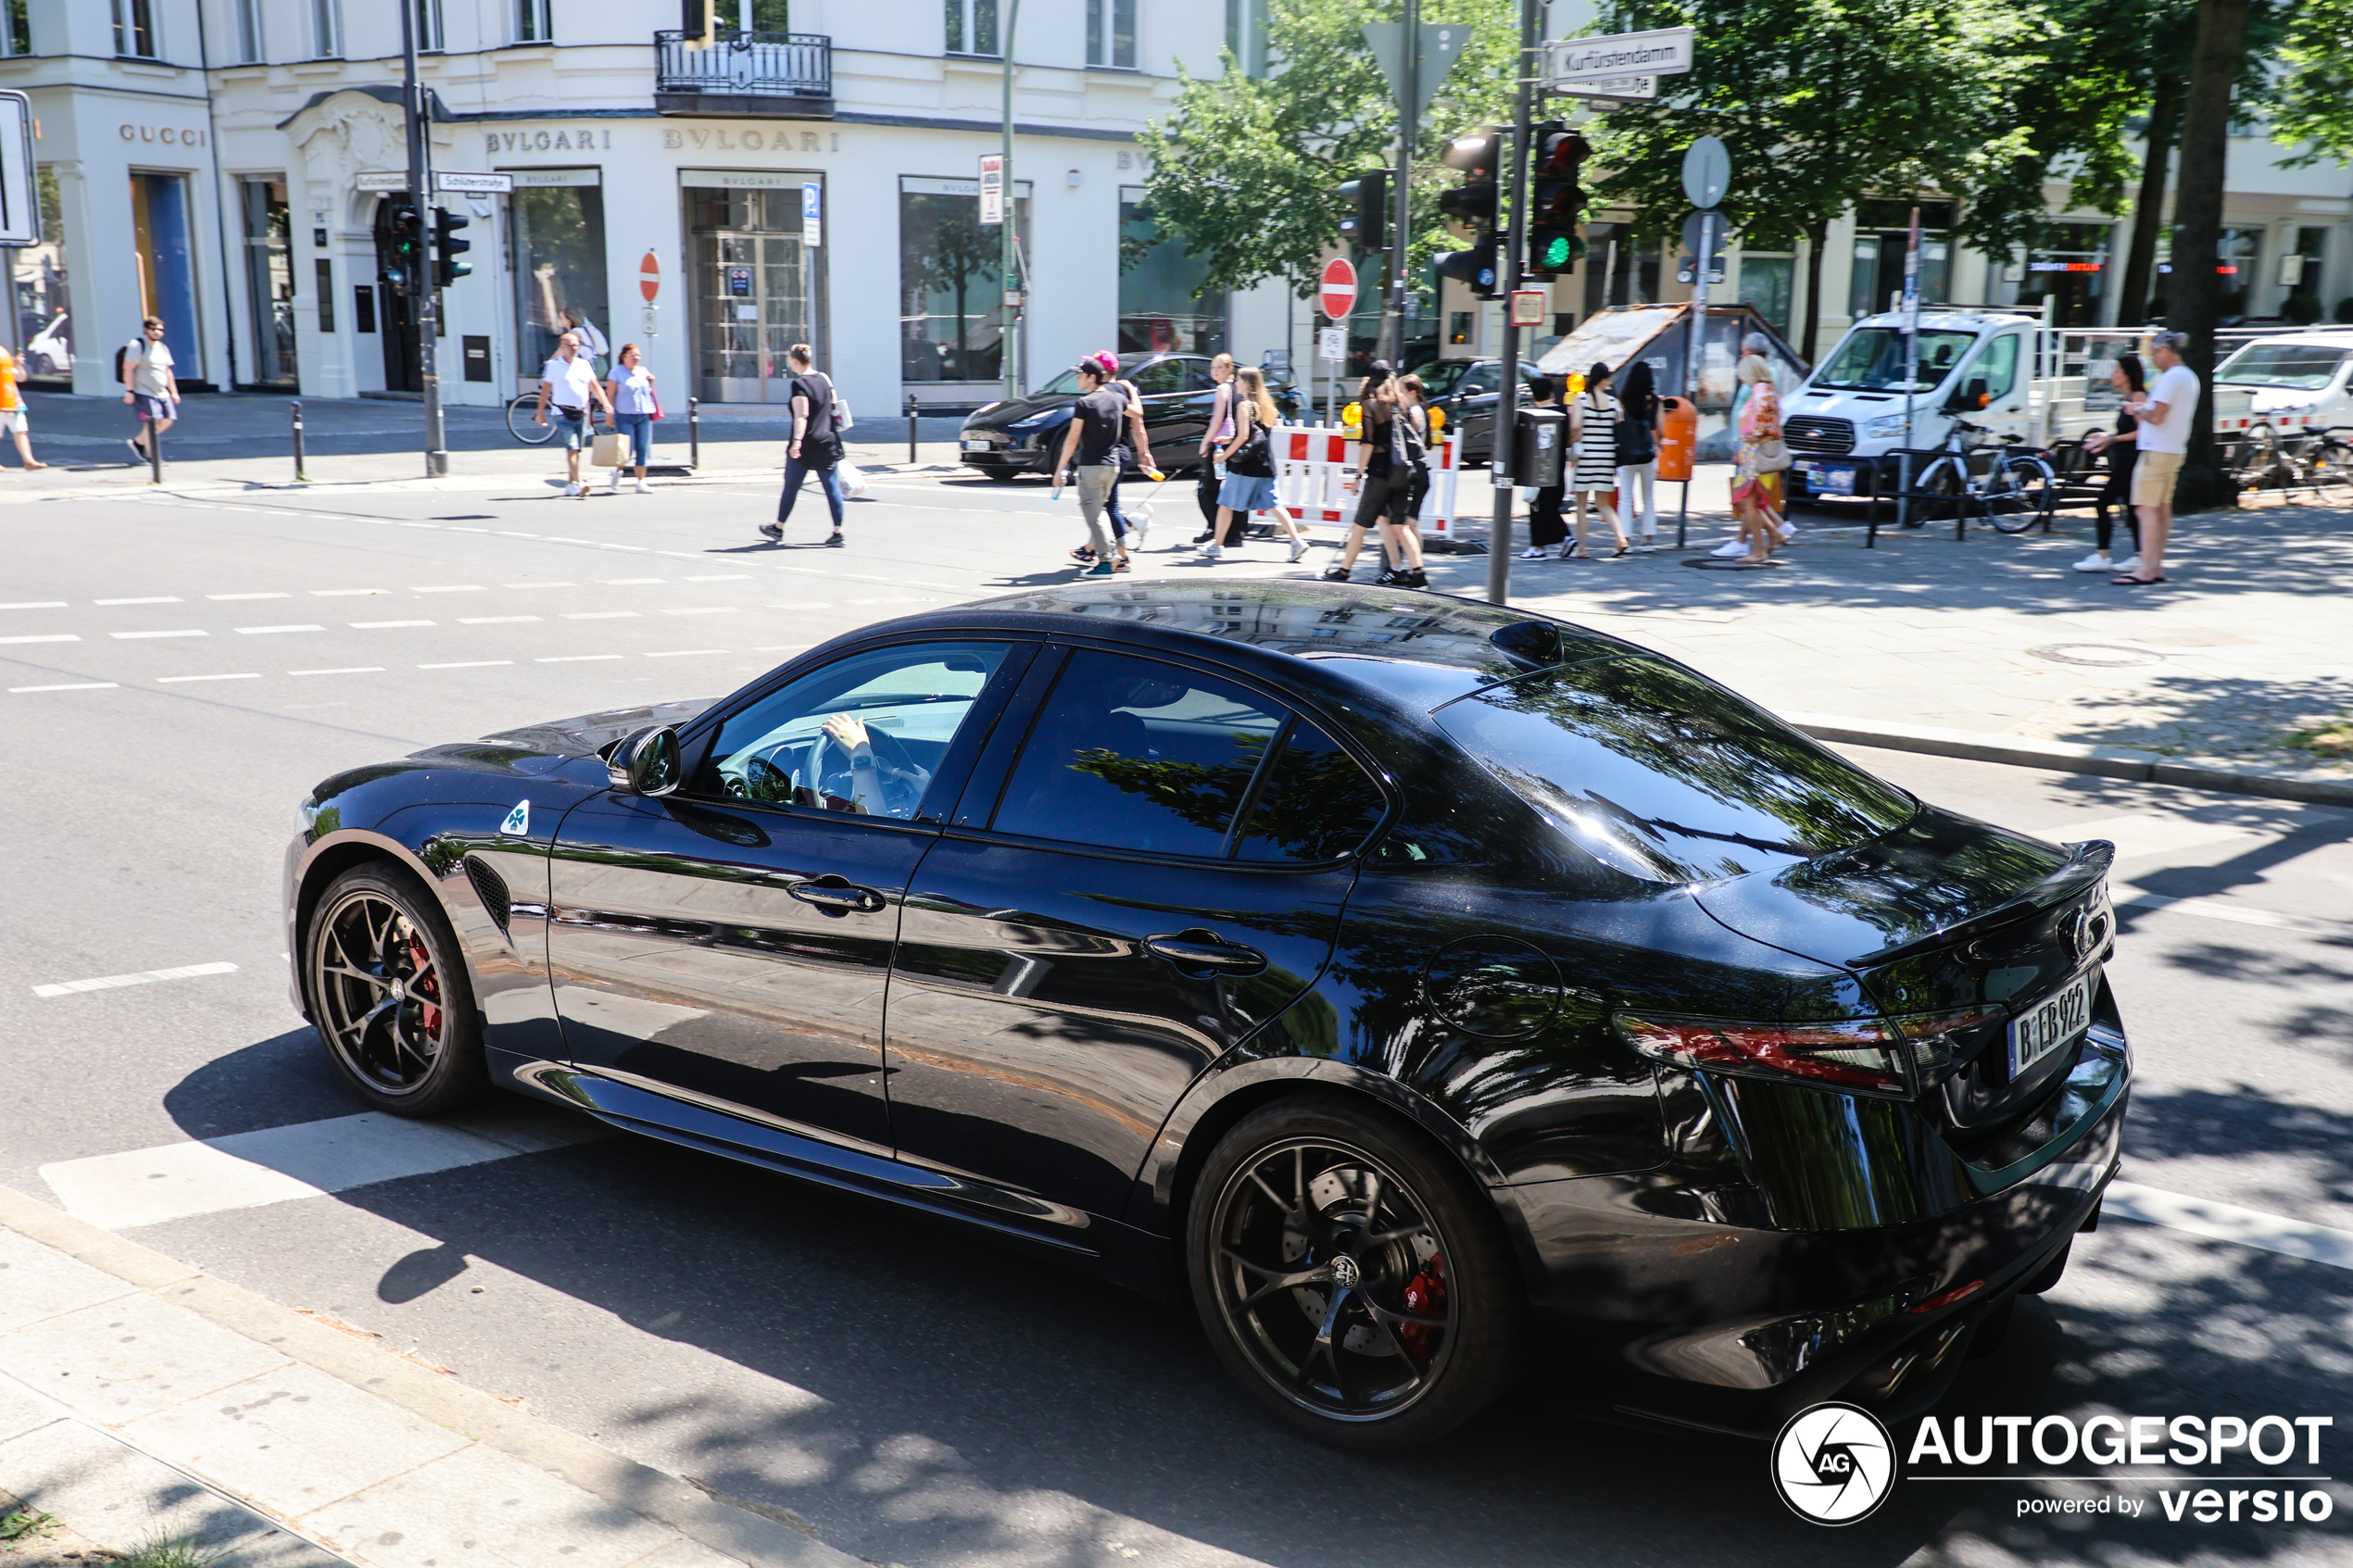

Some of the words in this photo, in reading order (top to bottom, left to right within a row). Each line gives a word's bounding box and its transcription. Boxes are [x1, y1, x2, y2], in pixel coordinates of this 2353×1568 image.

[1564, 45, 1677, 71] Kurfürstendamm
[119, 124, 206, 147] GUCCI
[486, 130, 611, 154] BVLGARI
[662, 129, 839, 152] BVLGARI
[445, 175, 504, 189] Schlüterstraße
[526, 175, 569, 183] BVLGARI
[723, 177, 781, 186] BVLGARI
[2020, 1020, 2031, 1065] B
